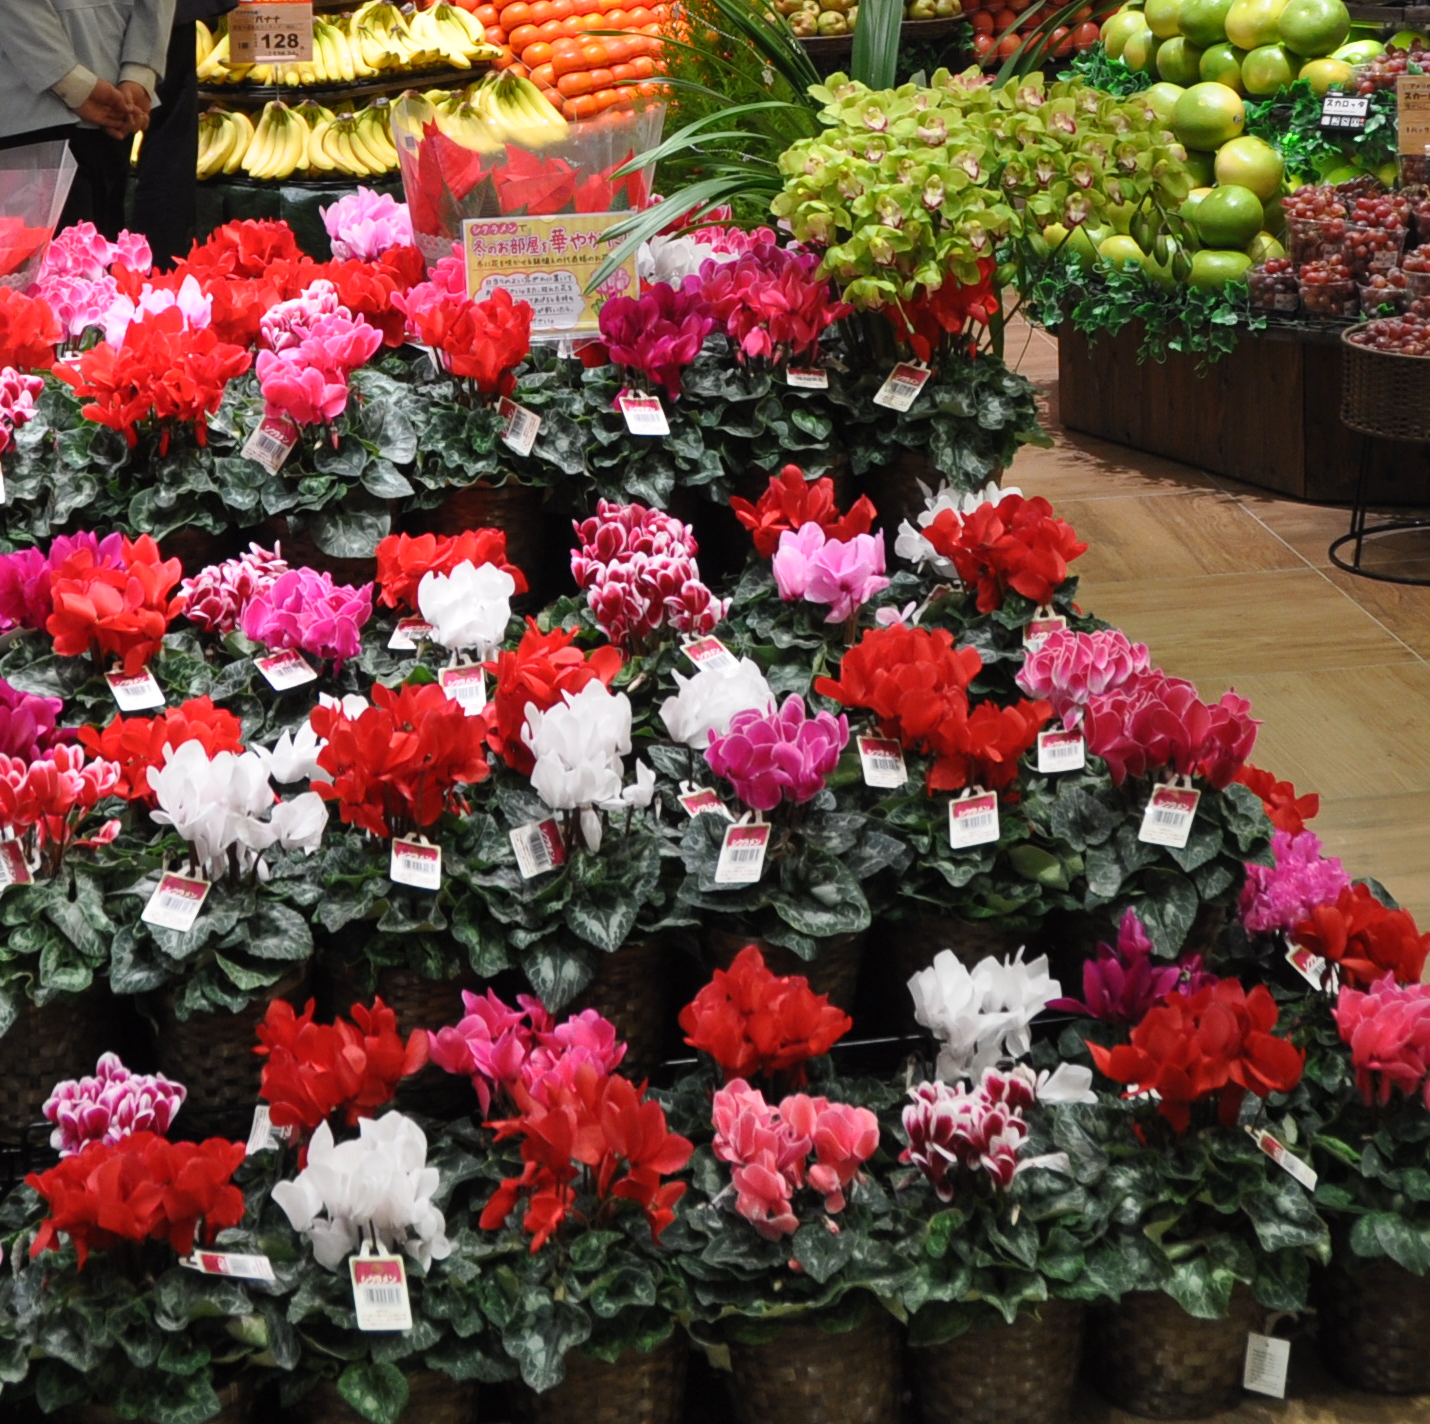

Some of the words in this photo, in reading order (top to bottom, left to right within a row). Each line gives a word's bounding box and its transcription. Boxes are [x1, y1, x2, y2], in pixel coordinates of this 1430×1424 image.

[261, 33, 299, 49] 128
[1327, 99, 1365, 108] スカロッタ
